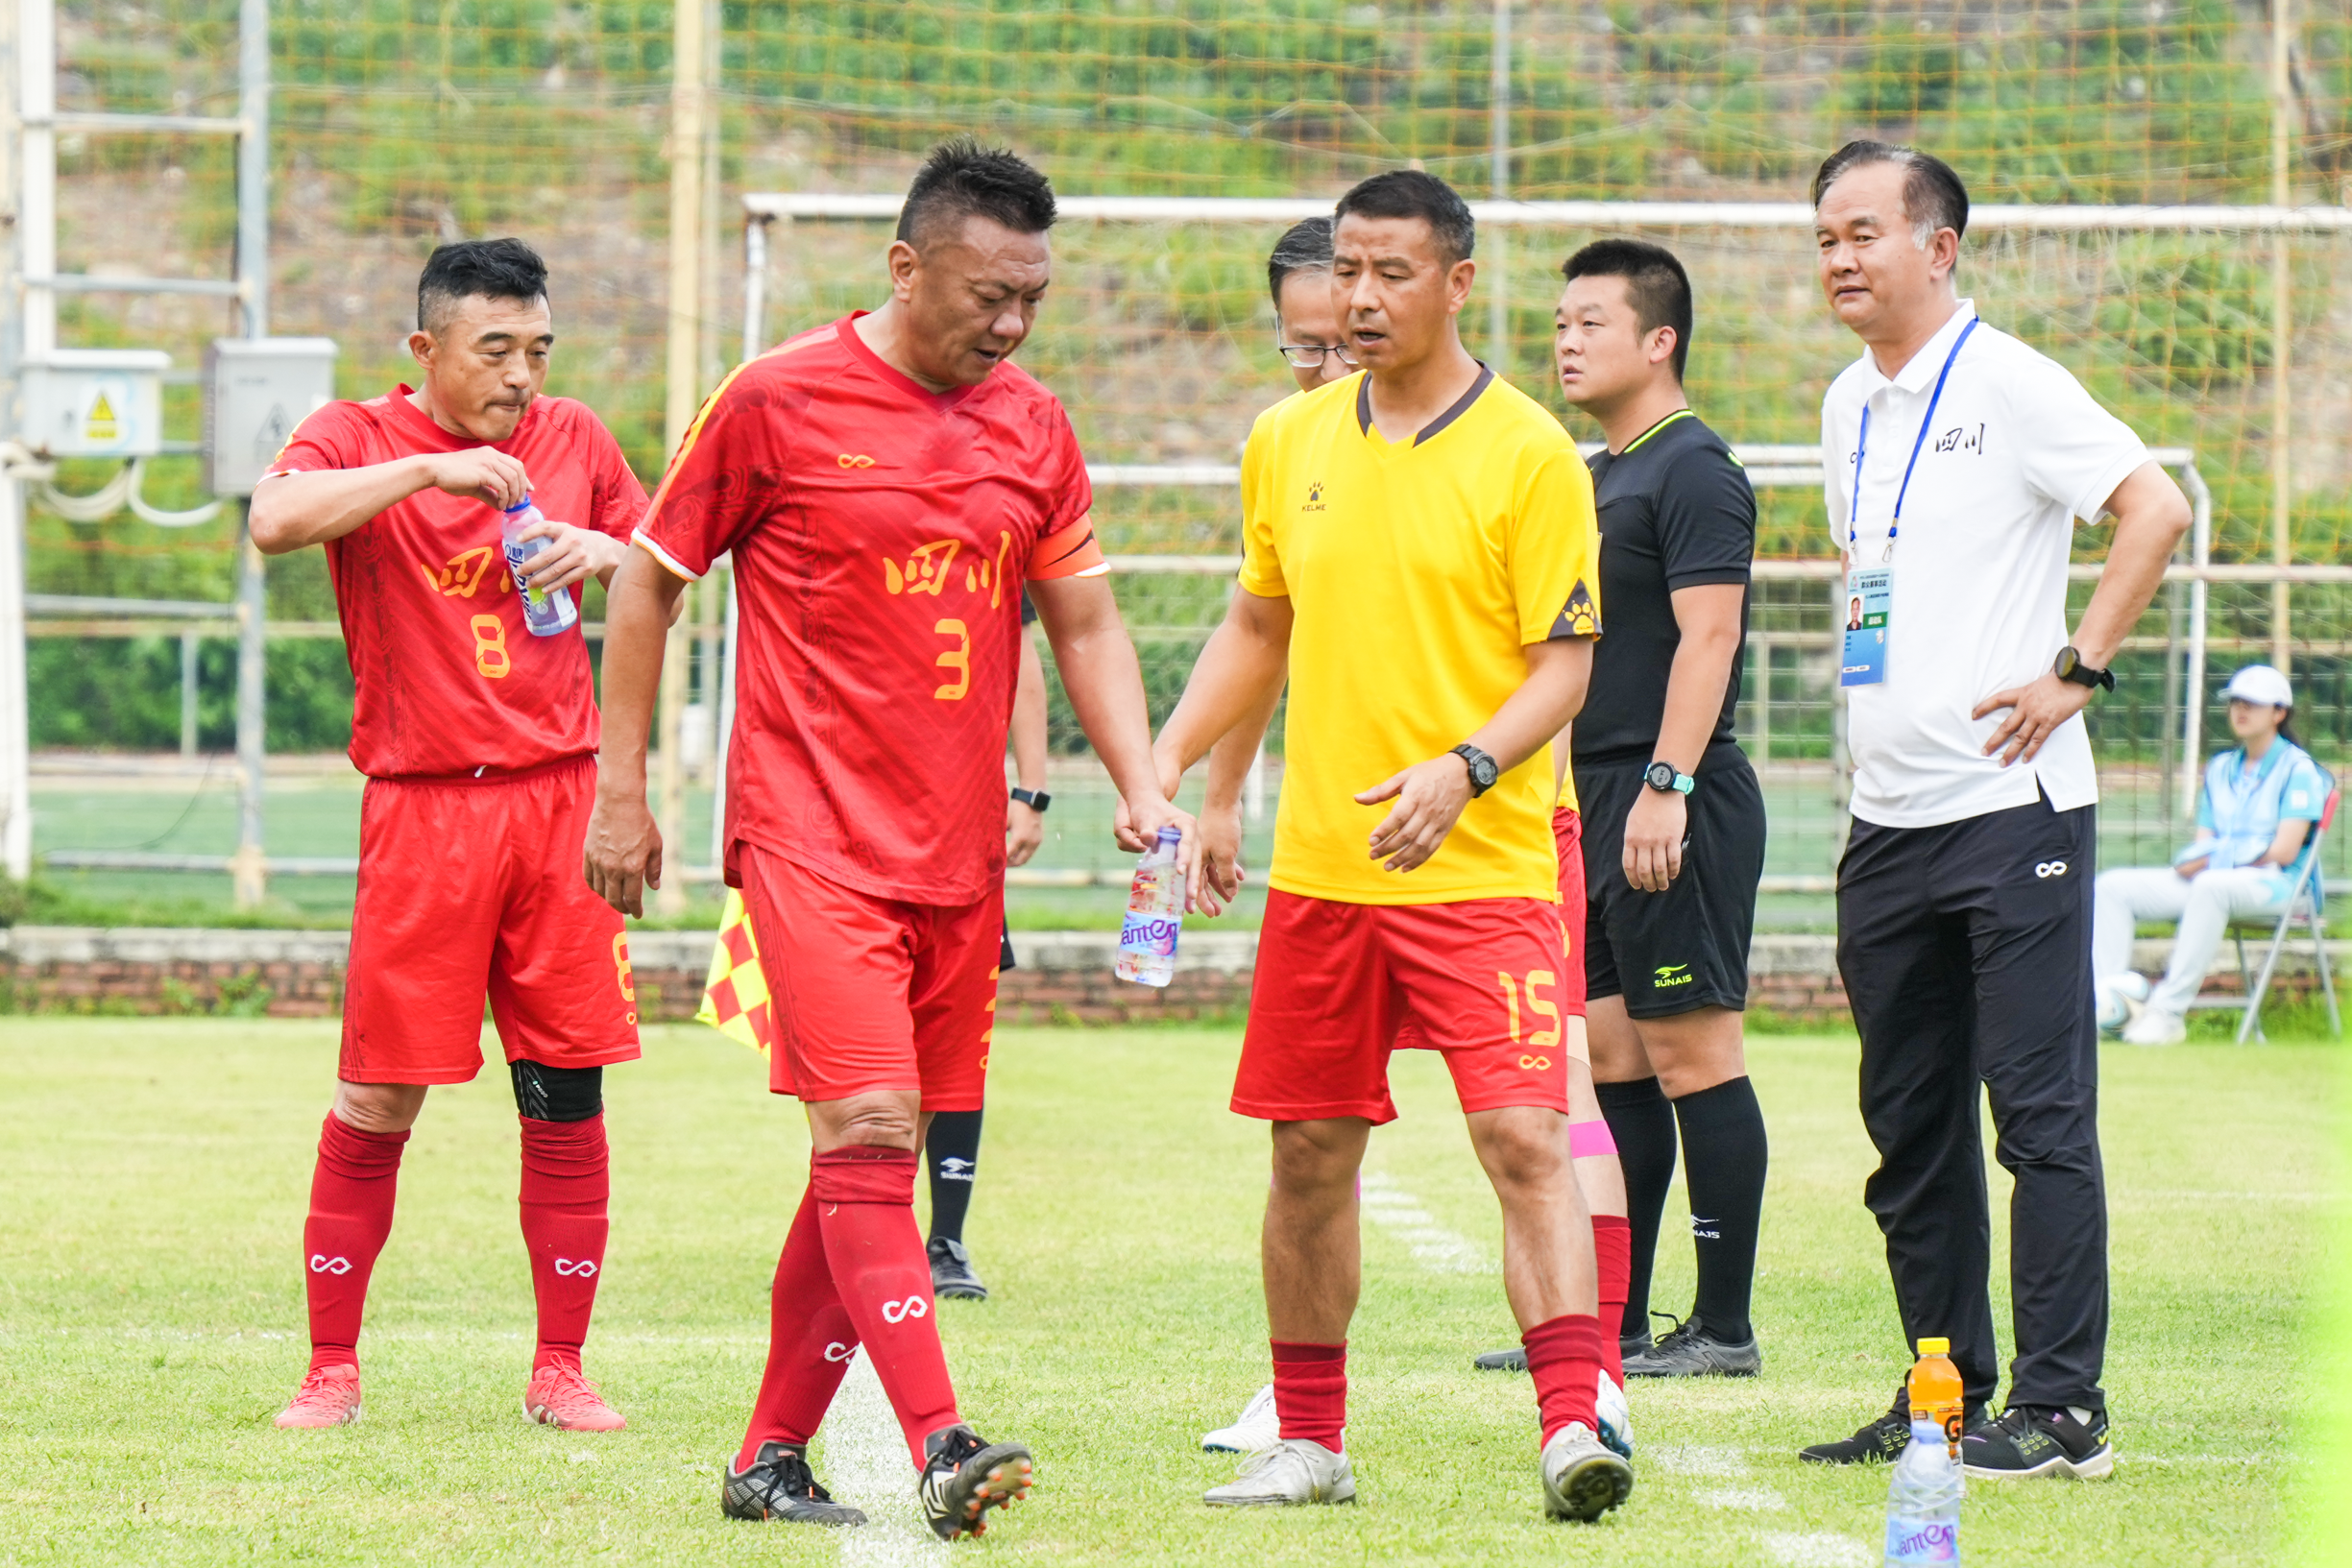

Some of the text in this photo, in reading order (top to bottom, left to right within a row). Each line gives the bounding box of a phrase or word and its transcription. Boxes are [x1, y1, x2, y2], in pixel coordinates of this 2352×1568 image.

[1935, 422, 1985, 455] 四川
[883, 530, 1011, 610] 四川
[470, 614, 511, 679] 8
[934, 618, 970, 700] 3
[1121, 919, 1177, 946] anten
[1654, 974, 1693, 988] SUNAIS
[1497, 969, 1562, 1048] 15
[1896, 1524, 1954, 1557] anten
